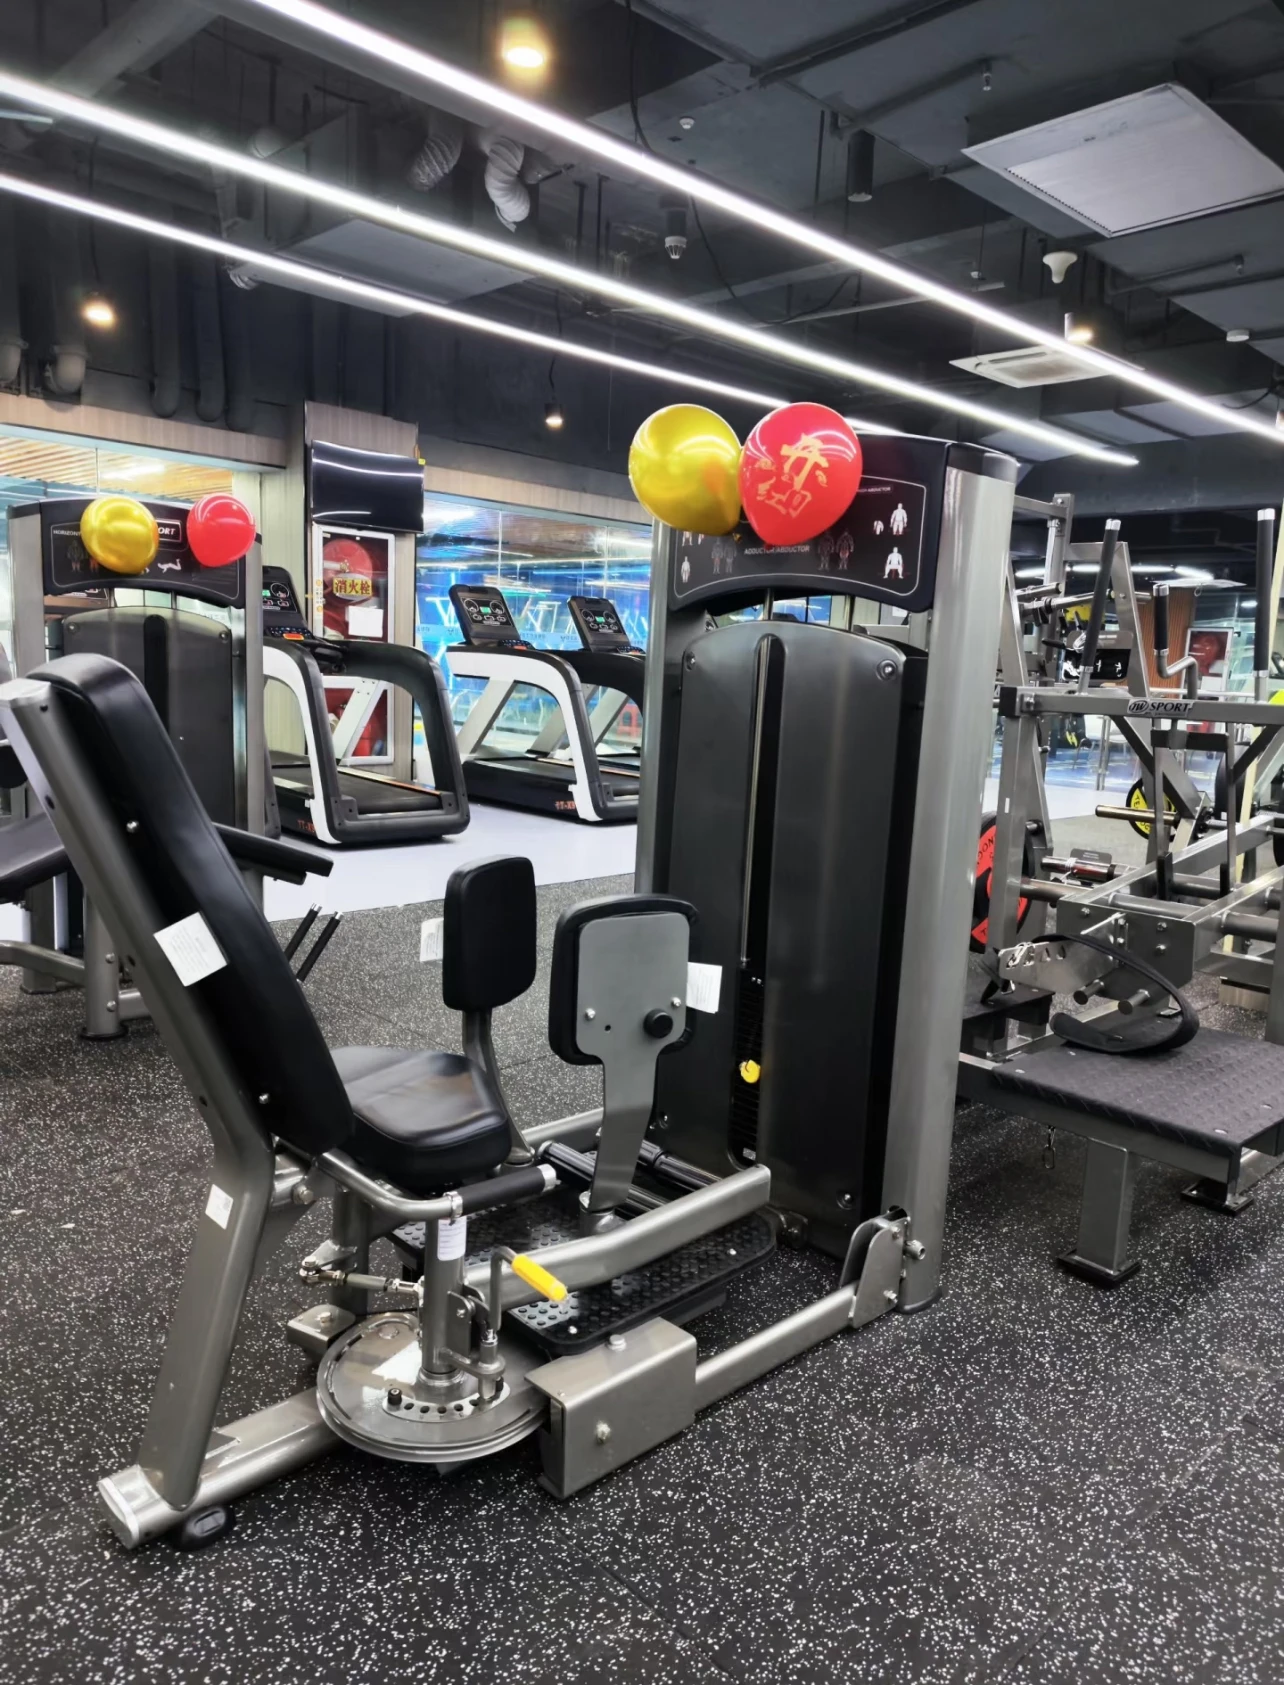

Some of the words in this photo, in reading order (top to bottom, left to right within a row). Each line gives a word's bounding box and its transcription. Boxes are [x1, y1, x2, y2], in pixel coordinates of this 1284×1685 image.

[53, 529, 81, 537] HORIZONT
[158, 527, 176, 536] ORT
[335, 579, 371, 595] 消火栓
[1150, 702, 1191, 713] SPORT
